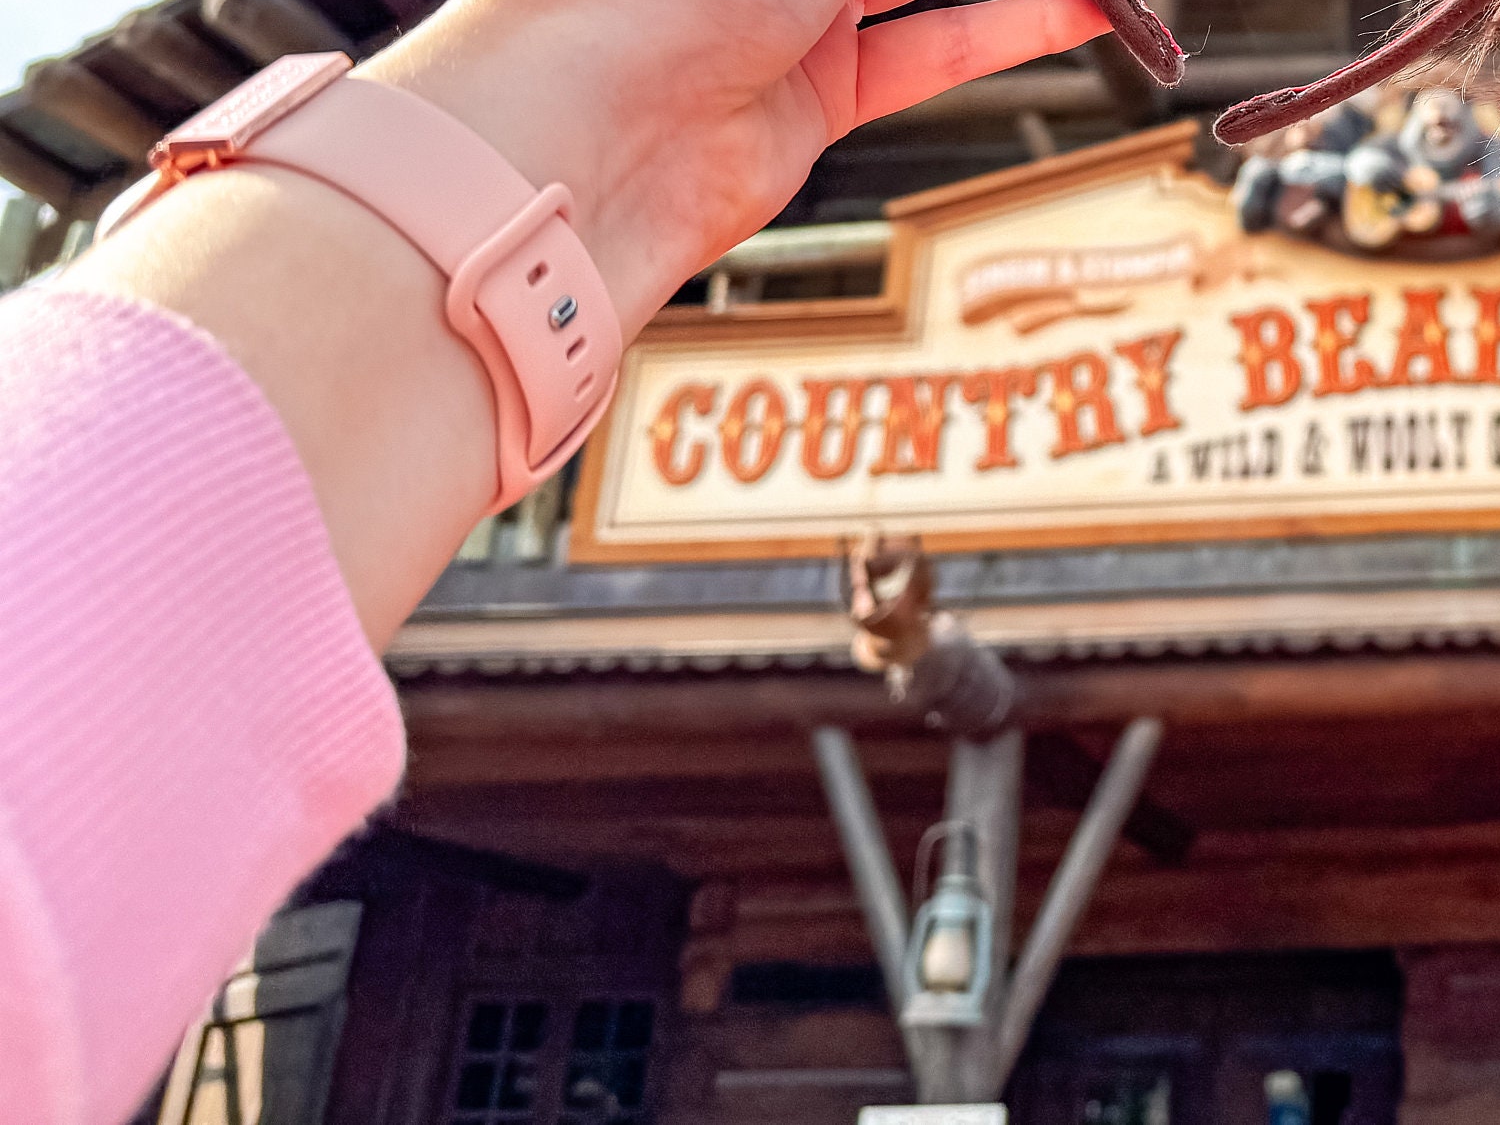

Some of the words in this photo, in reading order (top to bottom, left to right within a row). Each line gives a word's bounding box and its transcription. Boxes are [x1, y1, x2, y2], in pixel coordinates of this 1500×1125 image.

[652, 331, 1183, 486] COUNTRY
[1150, 447, 1173, 484] A
[1187, 427, 1284, 482] WILD
[1300, 420, 1331, 476] &
